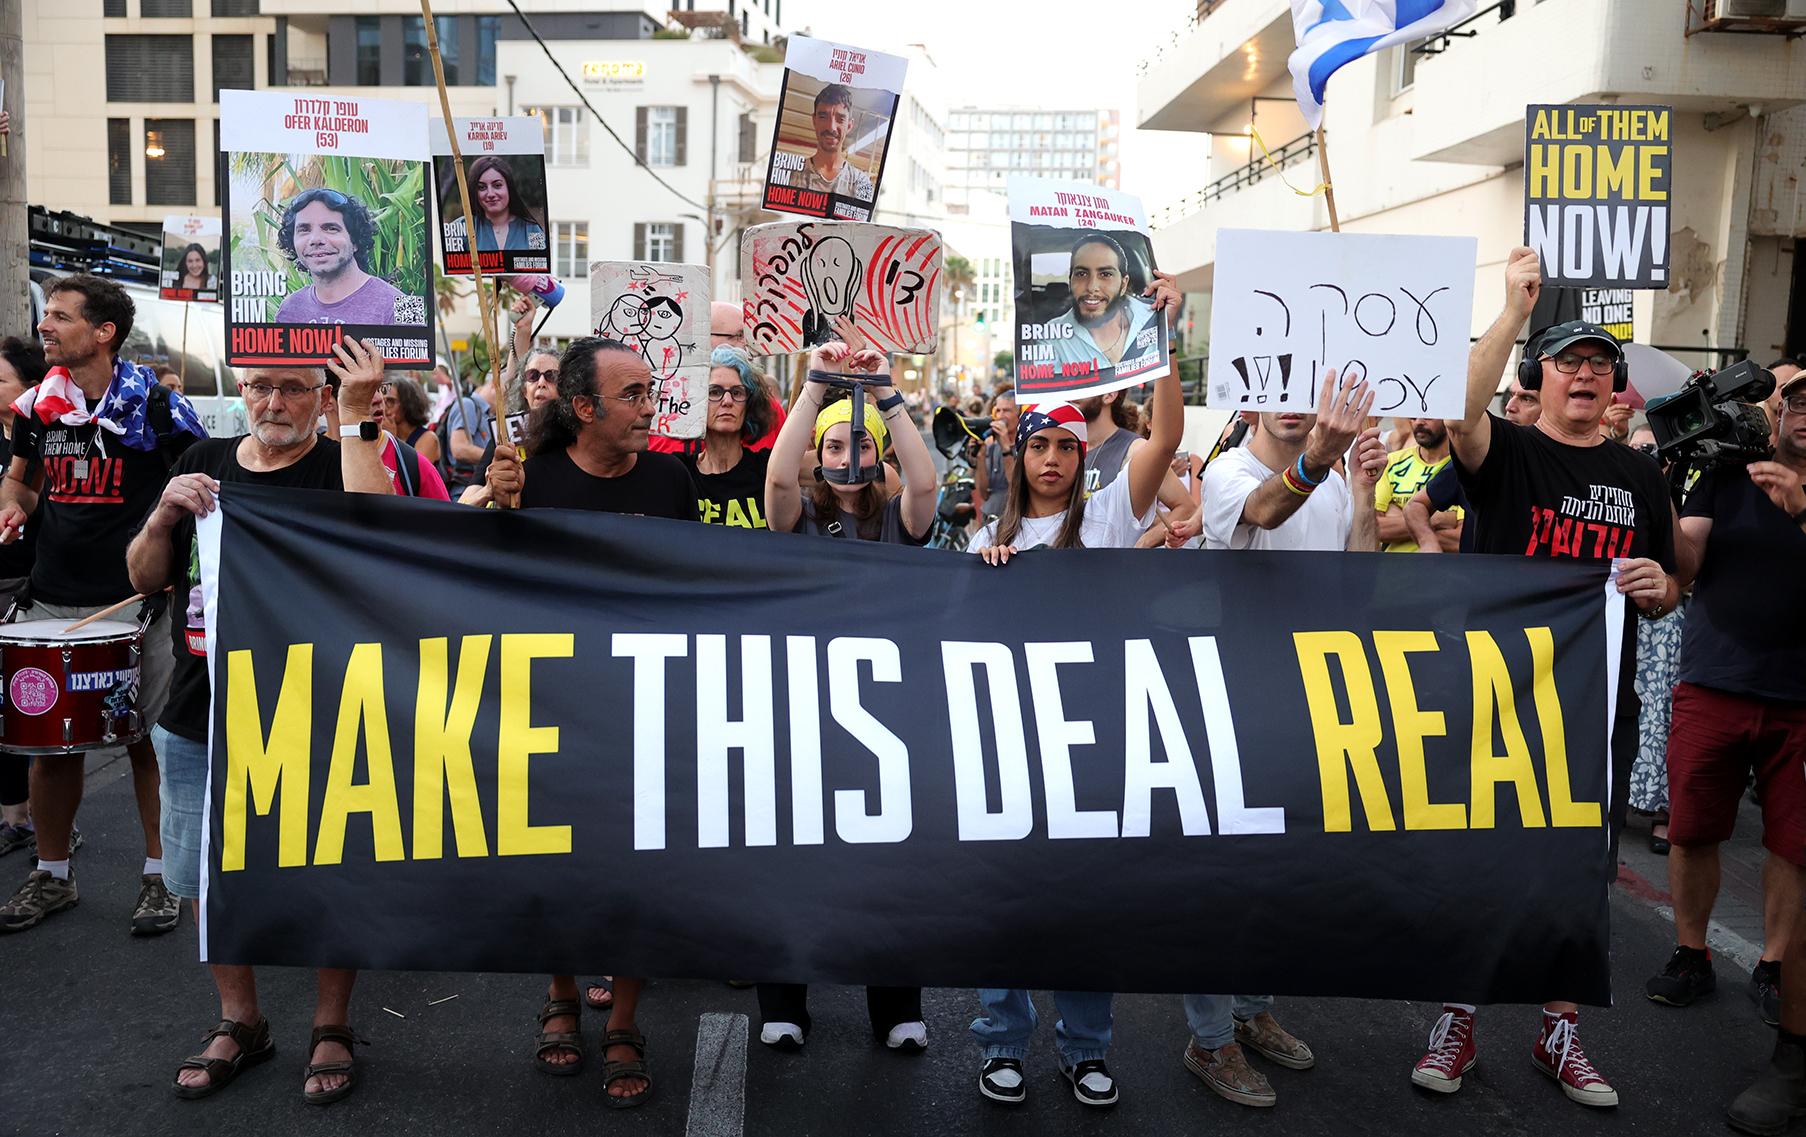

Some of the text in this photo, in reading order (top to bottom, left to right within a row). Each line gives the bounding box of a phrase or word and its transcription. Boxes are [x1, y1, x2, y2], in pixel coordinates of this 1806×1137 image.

[829, 59, 865, 74] ARIEL CUNIO
[849, 51, 866, 64] אריאל
[583, 62, 645, 76] renoma
[840, 72, 852, 84] (26)
[294, 99, 358, 116] עופר קלדרון
[285, 114, 368, 133] OFER KALDERON
[1531, 110, 1668, 141] ALL OF THEM
[316, 131, 338, 149] (53)
[467, 132, 507, 141] KARINA ARIEV
[482, 141, 494, 151] (19)
[773, 151, 806, 172] BRING
[770, 168, 792, 186] HIM
[1530, 144, 1668, 201] HOME
[767, 186, 797, 205] HOME
[797, 191, 829, 211] NOW!
[1093, 196, 1110, 210] מתן
[1030, 206, 1136, 226] MATAN ZANGAUKER
[1078, 218, 1096, 228] (24)
[443, 222, 468, 237] BRIN
[445, 237, 464, 252] HER
[1529, 204, 1667, 281] NOW!
[231, 270, 287, 296] BRING
[1582, 288, 1633, 307] LEAVING
[231, 298, 267, 323] HIM
[1582, 303, 1633, 325] NO ONE
[1021, 322, 1073, 340] BRING
[1253, 283, 1450, 366] עסקה
[231, 328, 284, 354] HOME
[400, 347, 429, 360] FORUM
[1021, 344, 1054, 361] HIM
[1020, 363, 1055, 380] HOME
[1061, 357, 1099, 378] NOW!
[658, 396, 691, 415] The
[46, 429, 67, 443] BRING
[44, 442, 86, 456] THEM HOME
[44, 456, 123, 496] NOW!
[1589, 484, 1633, 508] מחזירים
[1560, 496, 1635, 527] אותם הביתה
[71, 671, 114, 690] בארצנו
[222, 627, 1602, 871] MAKE THIS DEAL REAL
